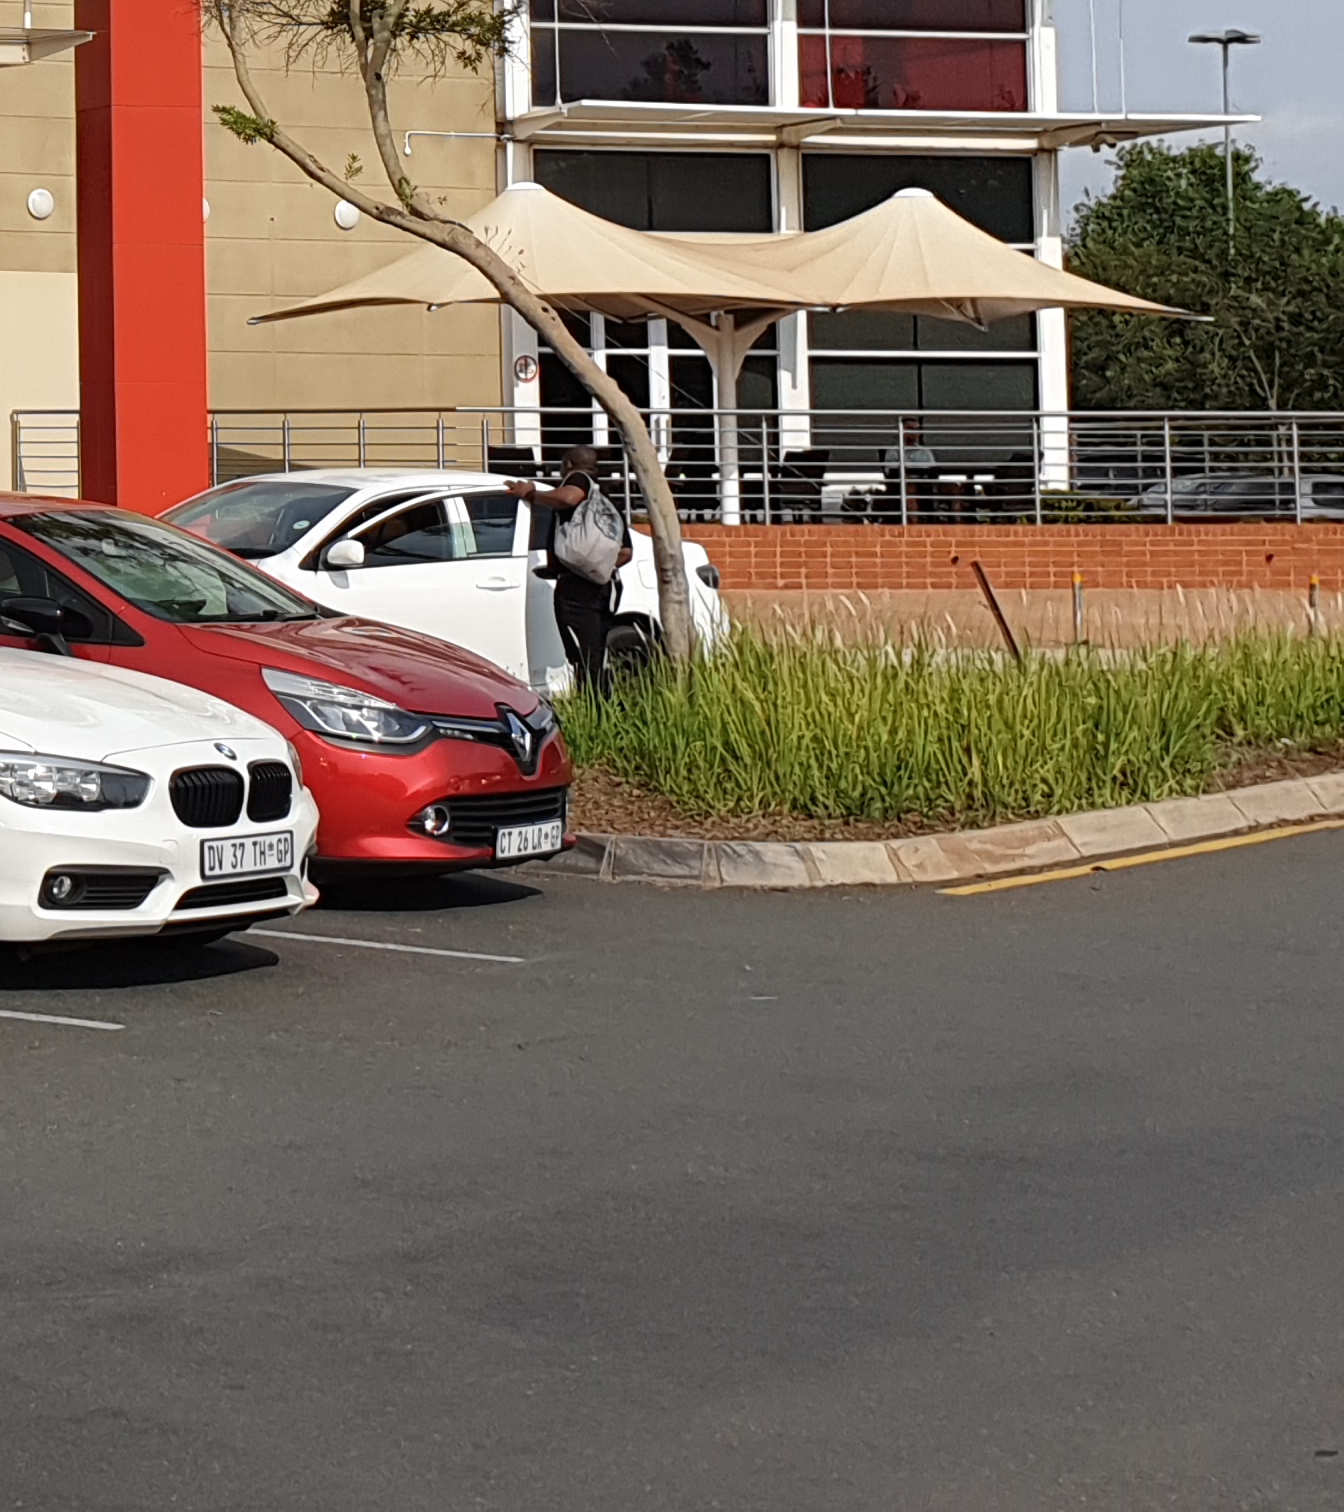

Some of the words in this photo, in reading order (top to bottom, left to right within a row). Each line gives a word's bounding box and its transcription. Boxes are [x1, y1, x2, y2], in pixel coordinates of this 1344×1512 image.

[207, 844, 224, 872] DV
[230, 842, 246, 869] 37
[251, 840, 267, 867] TH
[276, 837, 290, 864] GP
[499, 830, 513, 855] CT
[517, 829, 529, 853] 26
[531, 827, 543, 851] LR
[550, 824, 560, 849] GP
